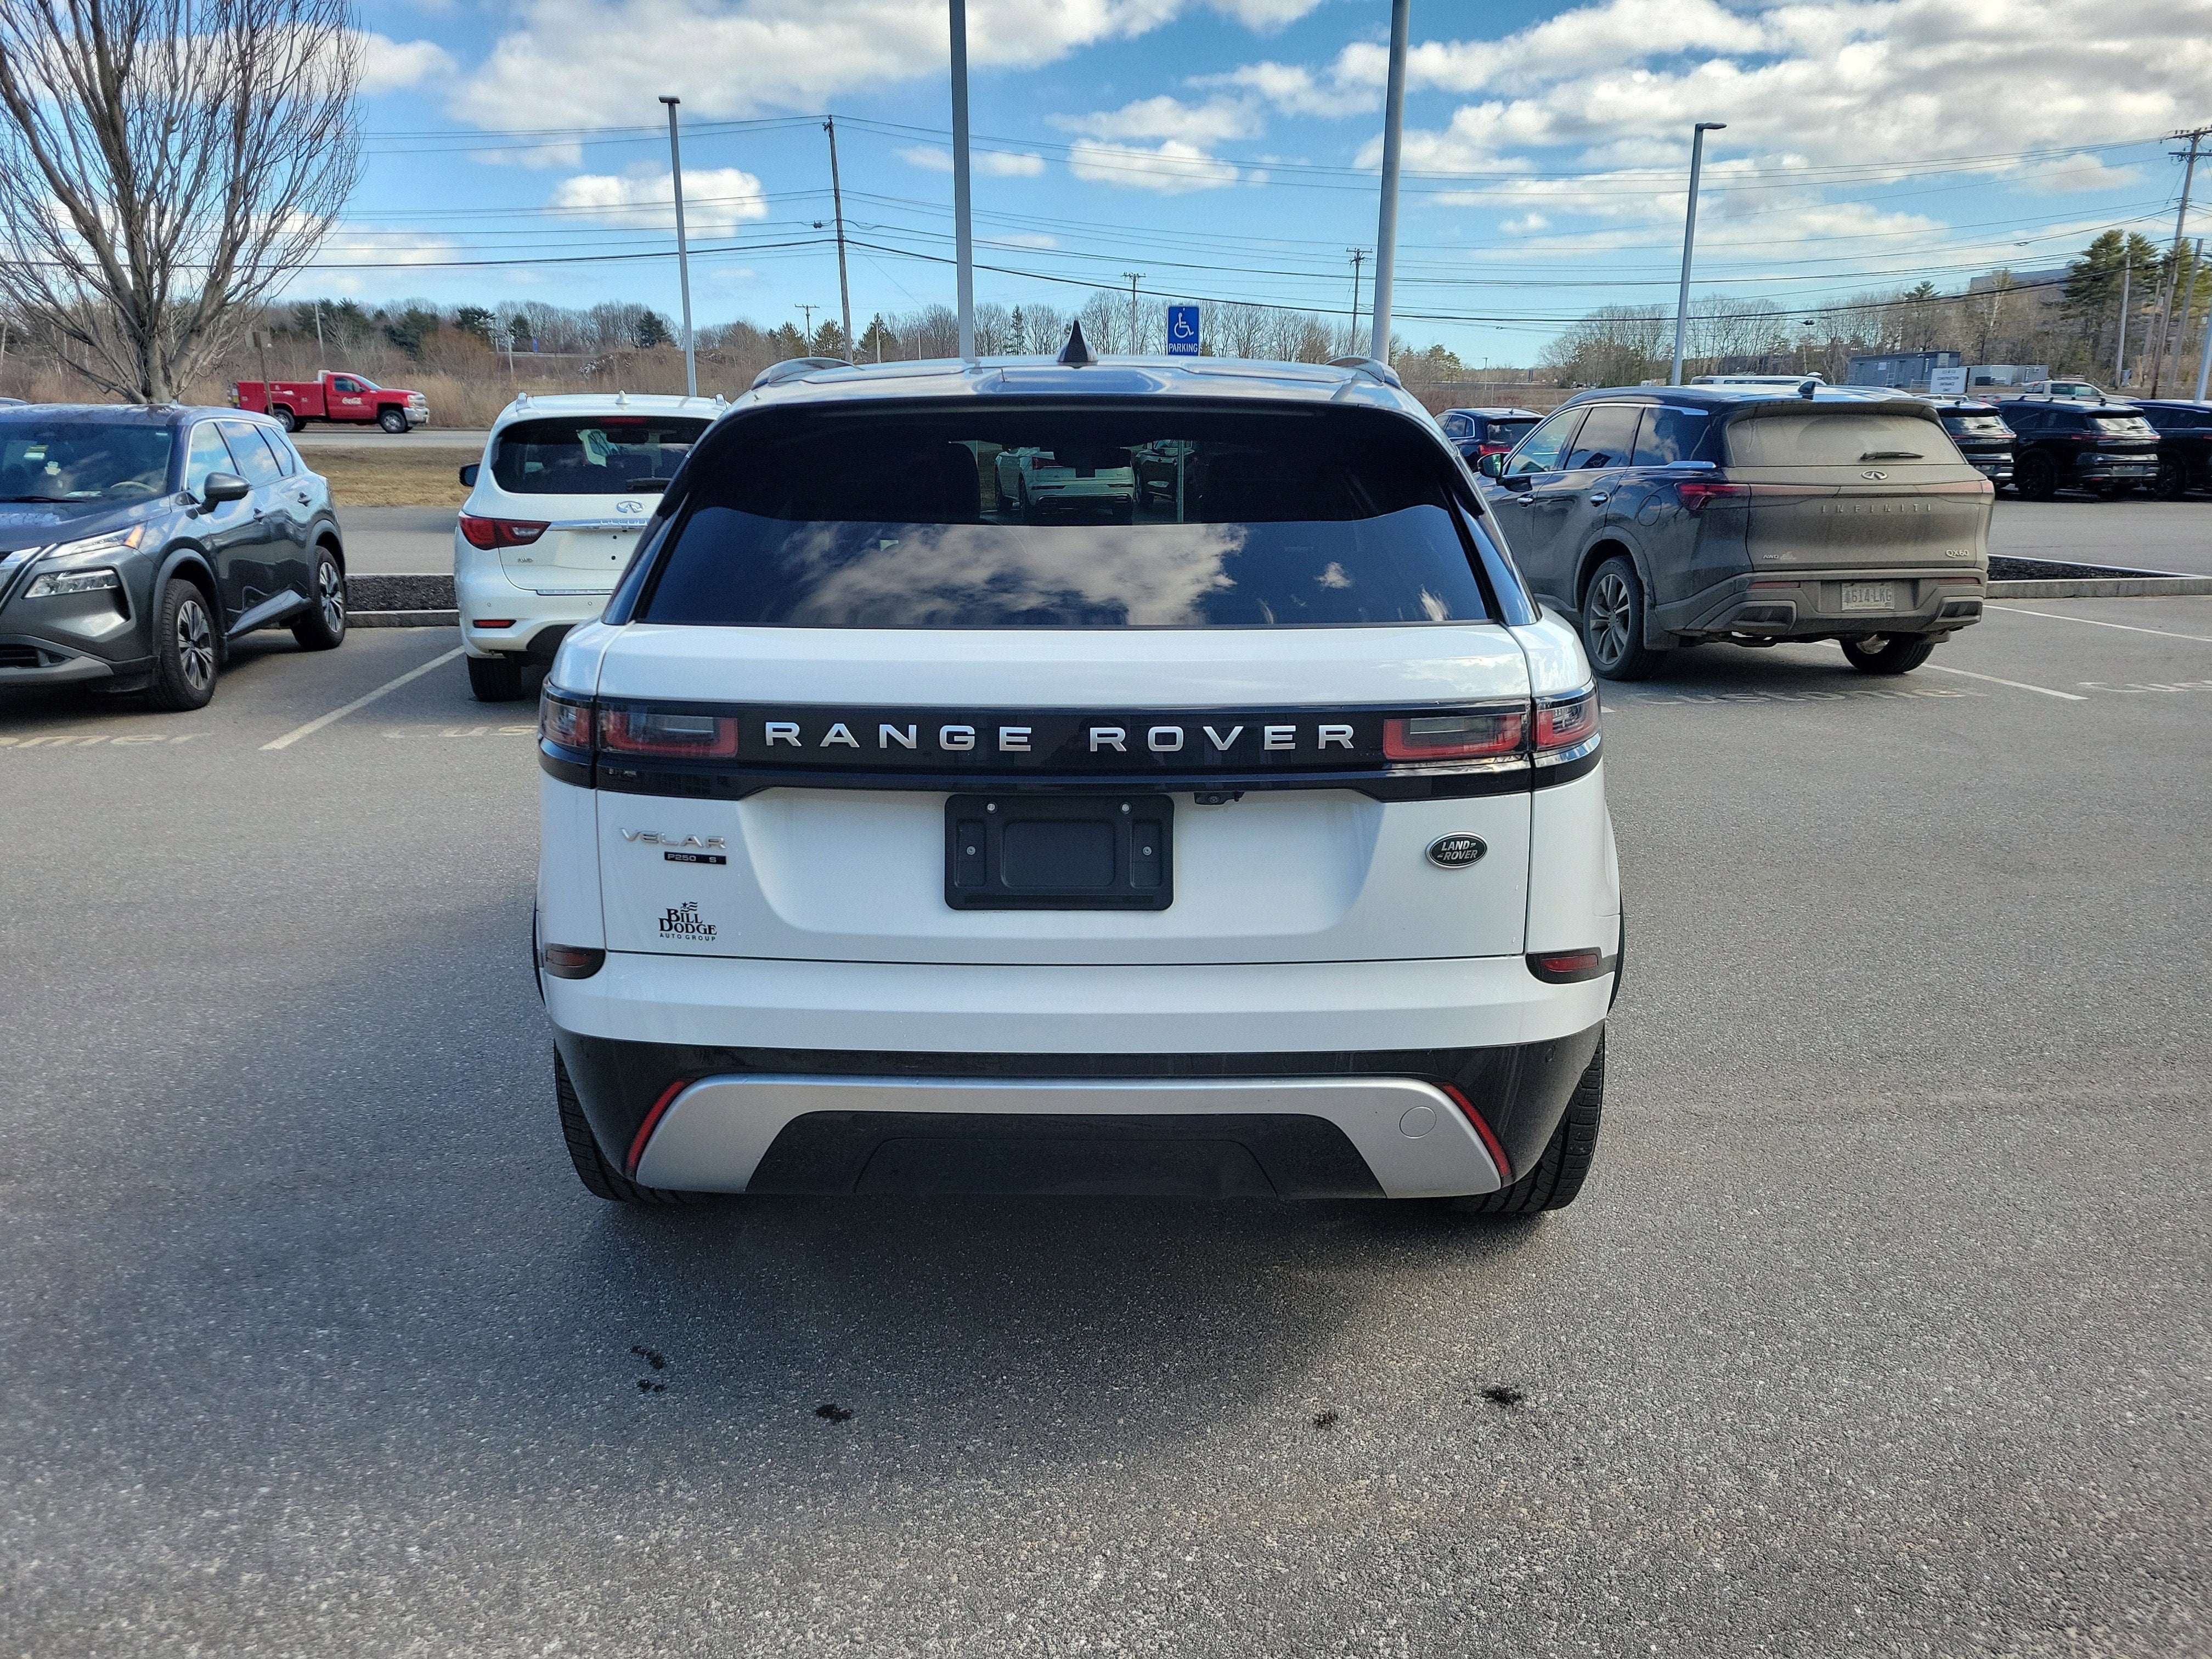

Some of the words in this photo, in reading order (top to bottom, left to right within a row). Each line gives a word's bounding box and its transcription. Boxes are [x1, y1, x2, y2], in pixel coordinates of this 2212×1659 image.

[1169, 343, 1198, 352] PARKING
[1822, 504, 1931, 513] INFINITI
[1946, 549, 1969, 557] QX60
[765, 721, 1032, 752] RANGE
[1090, 724, 1355, 752] ROVER
[620, 827, 726, 849] VELAR
[1441, 840, 1470, 851] LAND
[667, 853, 697, 862] P250
[1443, 849, 1478, 860] ROVER
